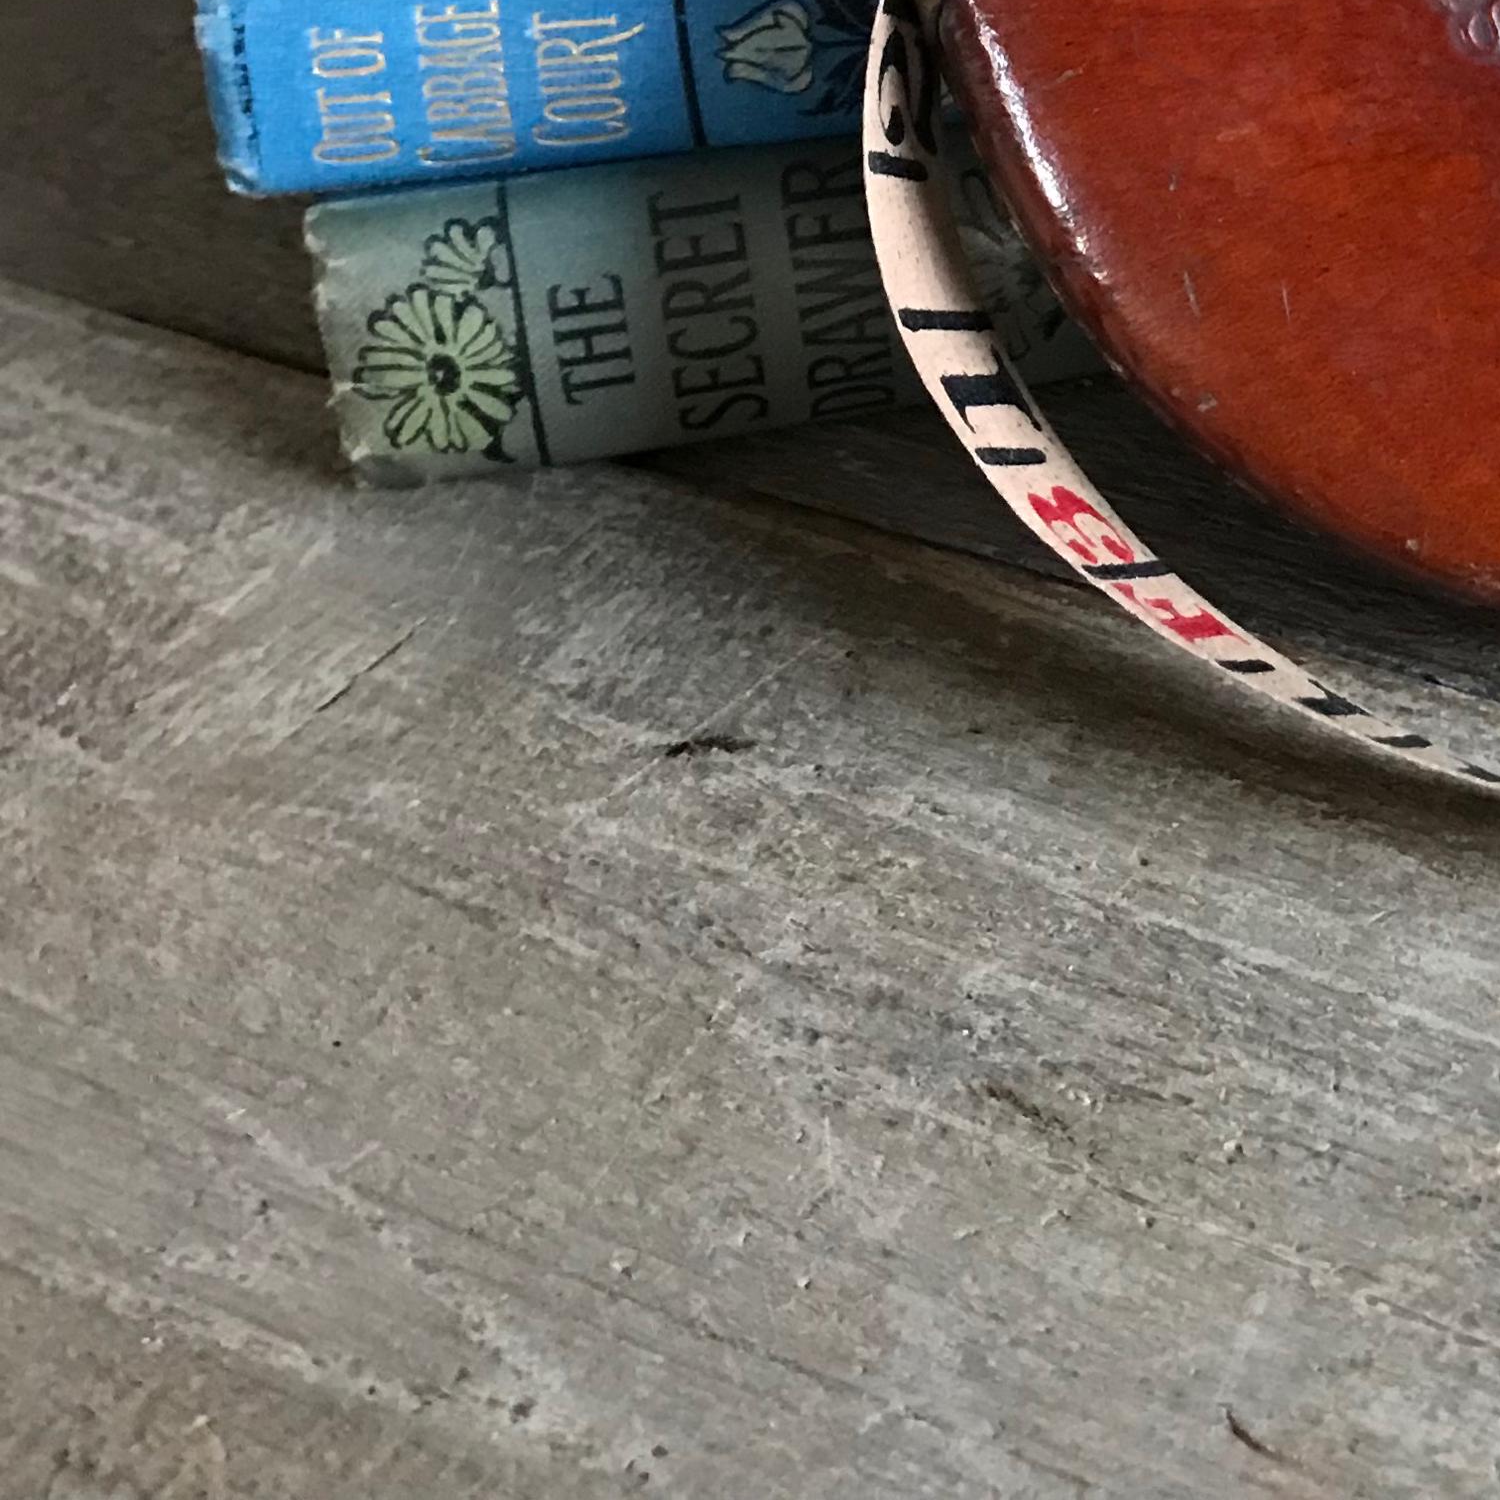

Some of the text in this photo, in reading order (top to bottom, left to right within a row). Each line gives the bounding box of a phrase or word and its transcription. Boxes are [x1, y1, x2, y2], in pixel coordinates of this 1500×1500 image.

[309, 26, 400, 164] OUT OF
[532, 10, 646, 147] COURT
[546, 270, 637, 407] THE
[646, 190, 770, 431] SECRET
